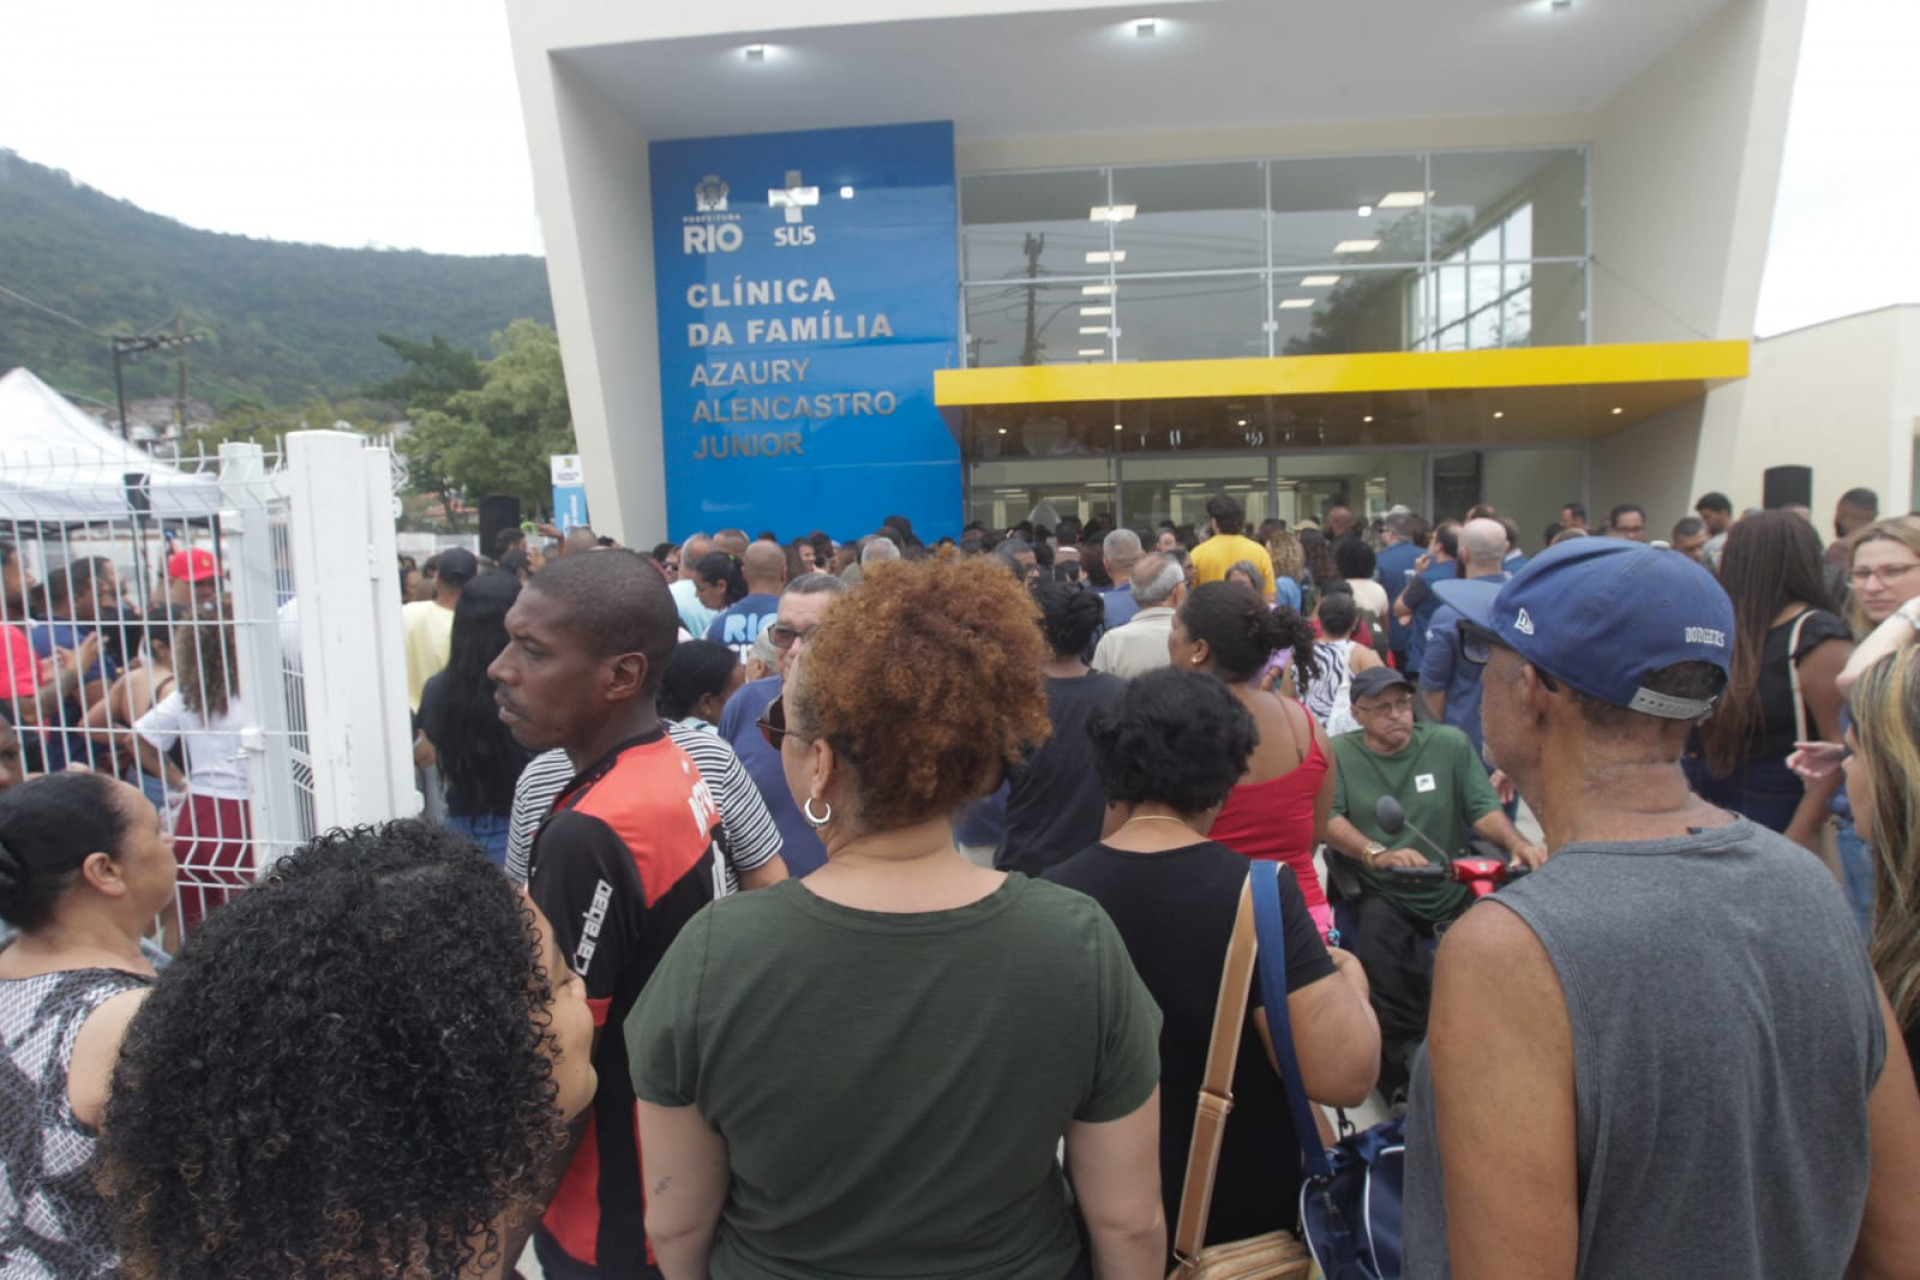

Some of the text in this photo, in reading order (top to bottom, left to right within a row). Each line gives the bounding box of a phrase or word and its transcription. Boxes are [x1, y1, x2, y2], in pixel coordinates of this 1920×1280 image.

[683, 222, 744, 254] RIO
[774, 226, 816, 246] SUS
[687, 275, 835, 308] CLÍNICA
[689, 310, 893, 347] DA FAMÍLIA
[691, 358, 810, 387] AZAURY
[692, 391, 896, 423] ALENCASTRO
[693, 432, 804, 460] JUNIOR
